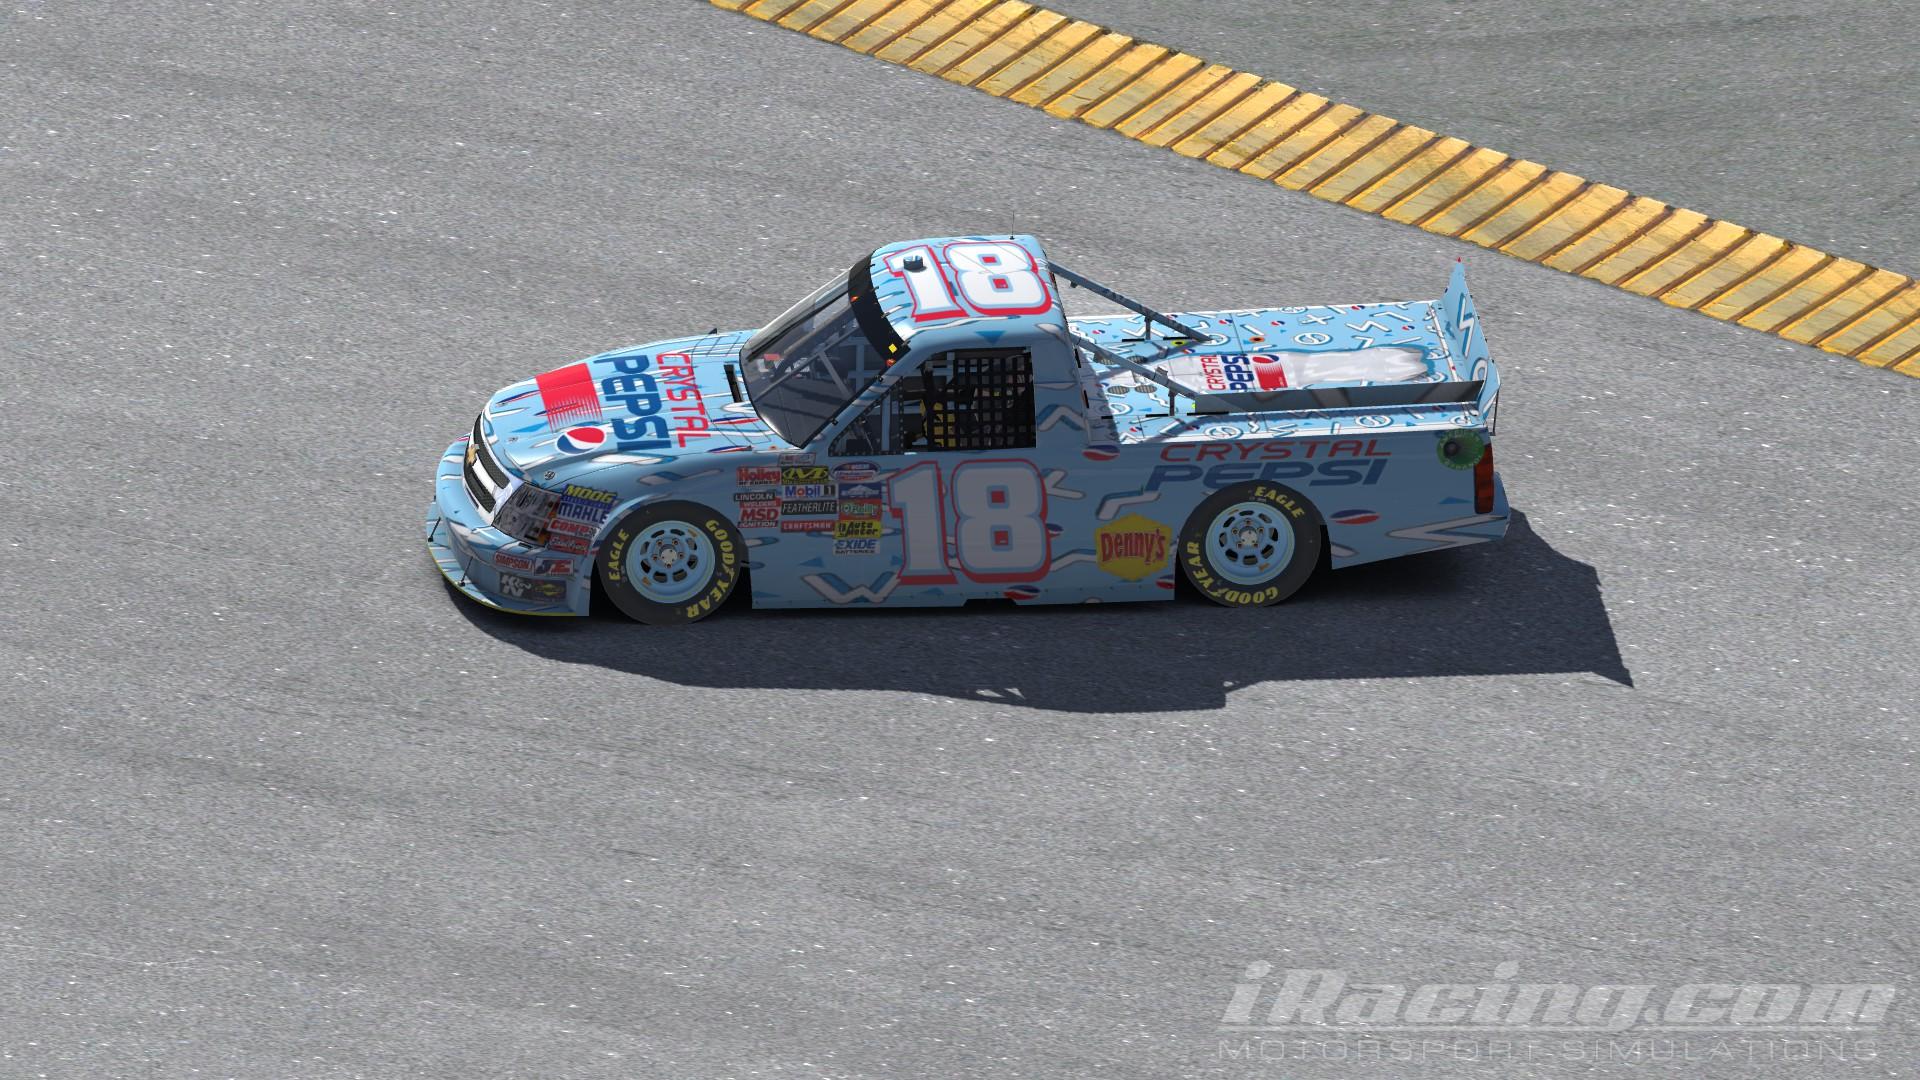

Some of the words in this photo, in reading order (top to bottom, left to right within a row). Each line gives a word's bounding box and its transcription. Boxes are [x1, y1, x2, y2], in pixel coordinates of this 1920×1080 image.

[882, 241, 1053, 322] 18
[593, 354, 673, 450] PEPSI
[656, 353, 712, 448] CRYSTAL
[1160, 439, 1392, 462] CRYSTAL
[1144, 458, 1388, 492] PEPSI
[566, 484, 617, 503] MOOG
[736, 493, 773, 501] LINCOLN
[785, 486, 820, 497] Mobil
[1254, 486, 1305, 518] EAGLE
[558, 502, 608, 524] MAHLE
[740, 508, 779, 520] MSD
[783, 502, 835, 513] FEATHERLITE
[783, 521, 832, 530] CRAFTSMAN
[886, 458, 1052, 585] 18
[608, 528, 630, 580] EAGLE
[835, 539, 878, 550] EXIDE
[1100, 529, 1166, 566] Denny's
[496, 553, 529, 569] SIMPSON
[686, 519, 736, 618] GOODYEAR
[1186, 541, 1279, 604] GOODYEAR
